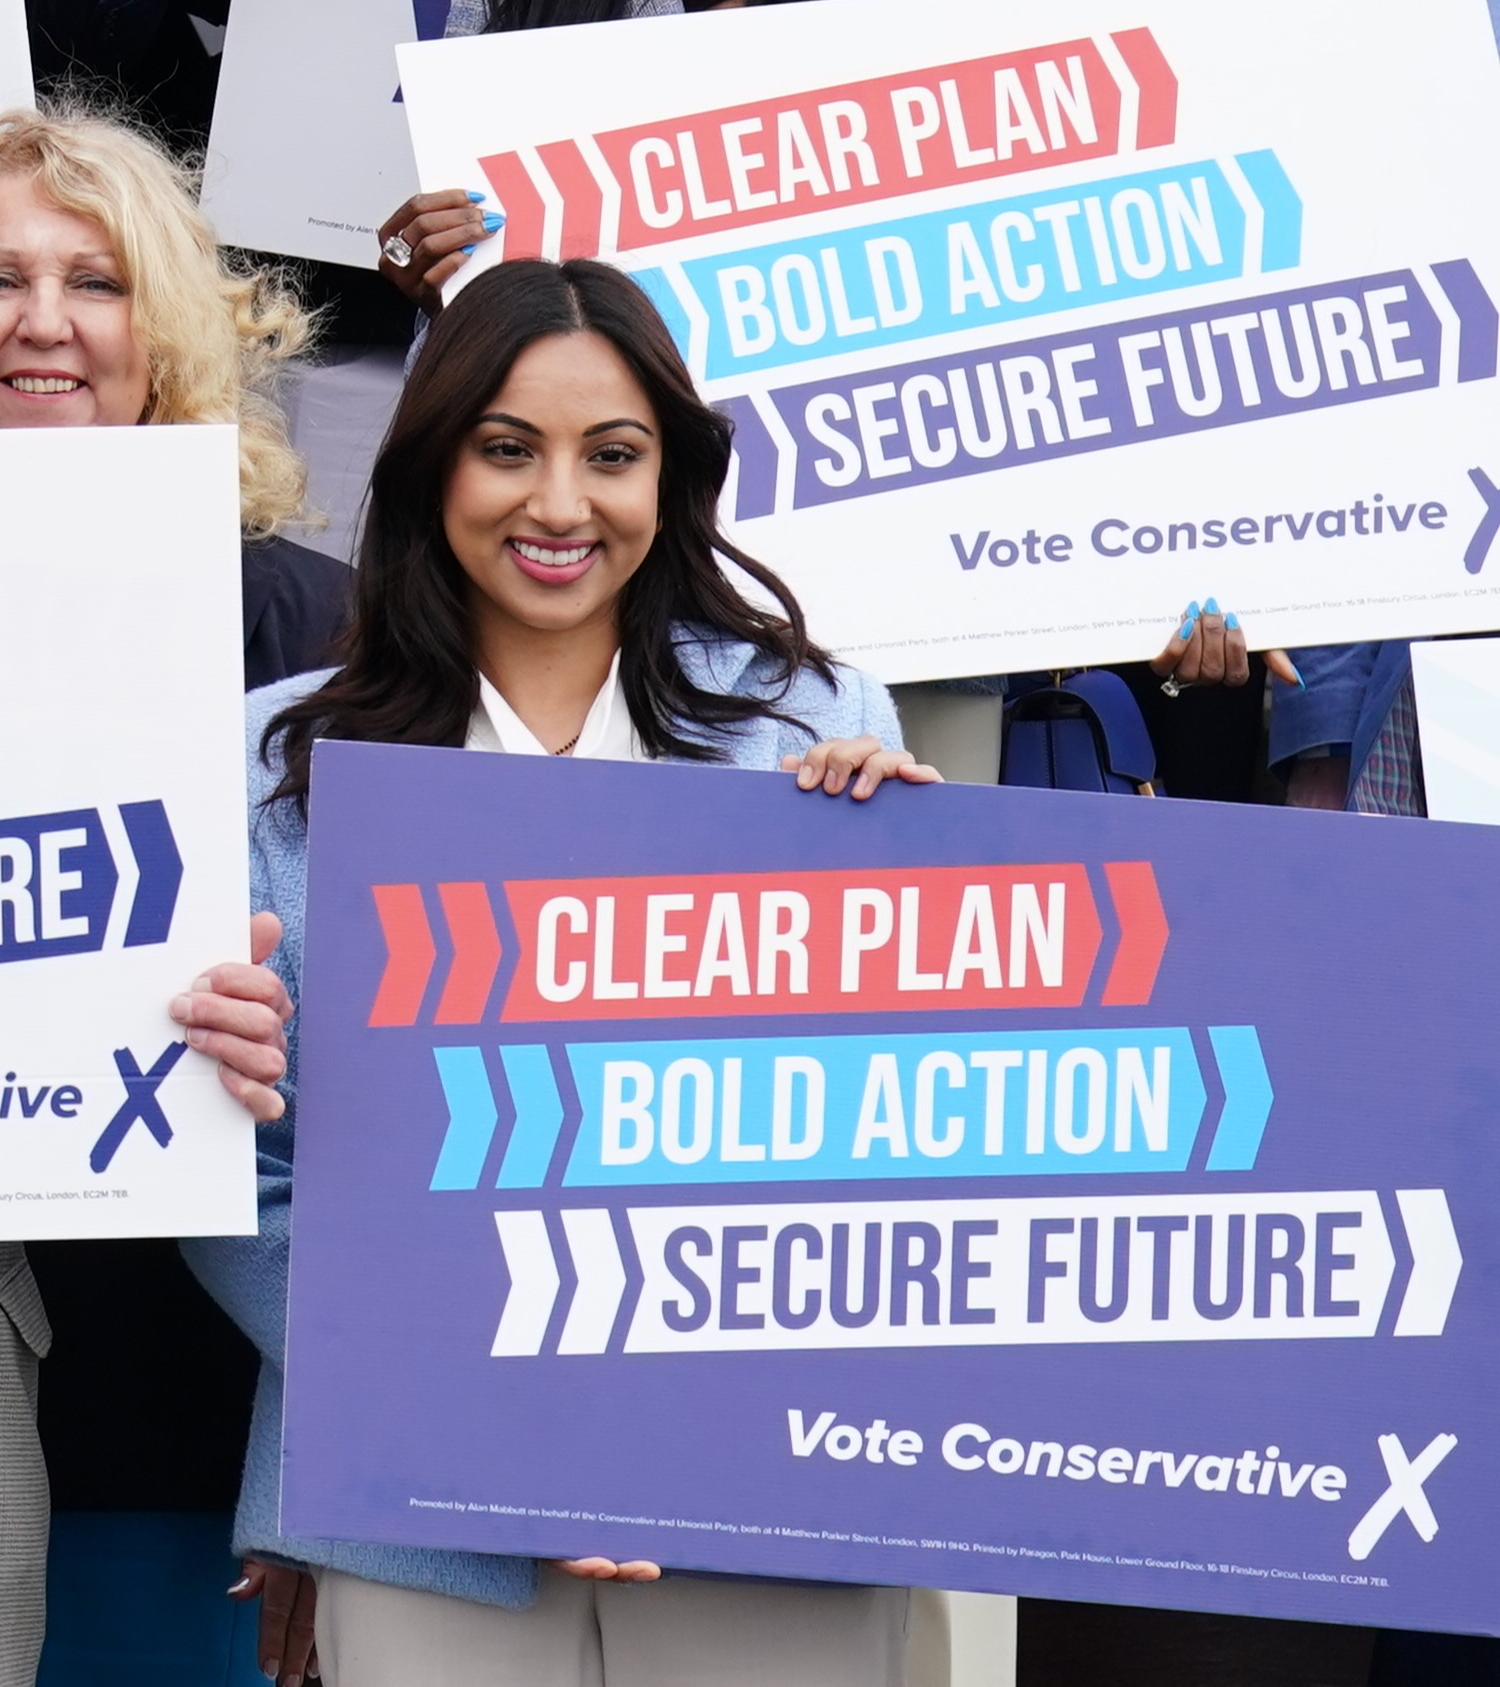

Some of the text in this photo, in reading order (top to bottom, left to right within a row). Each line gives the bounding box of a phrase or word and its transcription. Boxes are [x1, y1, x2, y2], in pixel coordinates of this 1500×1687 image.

[629, 56, 1098, 229] CLEAR PLAN
[716, 175, 1223, 359] BOLD ACTION
[806, 285, 1423, 487] SECURE FUTURE
[950, 495, 1448, 571] Vote Conservative
[535, 883, 1065, 1003] CLEAR PLAN
[601, 1045, 1172, 1166] BOLD ACTION
[661, 1210, 1362, 1334] SECURE FUTURE
[789, 1409, 1348, 1501] Vote Conservative
